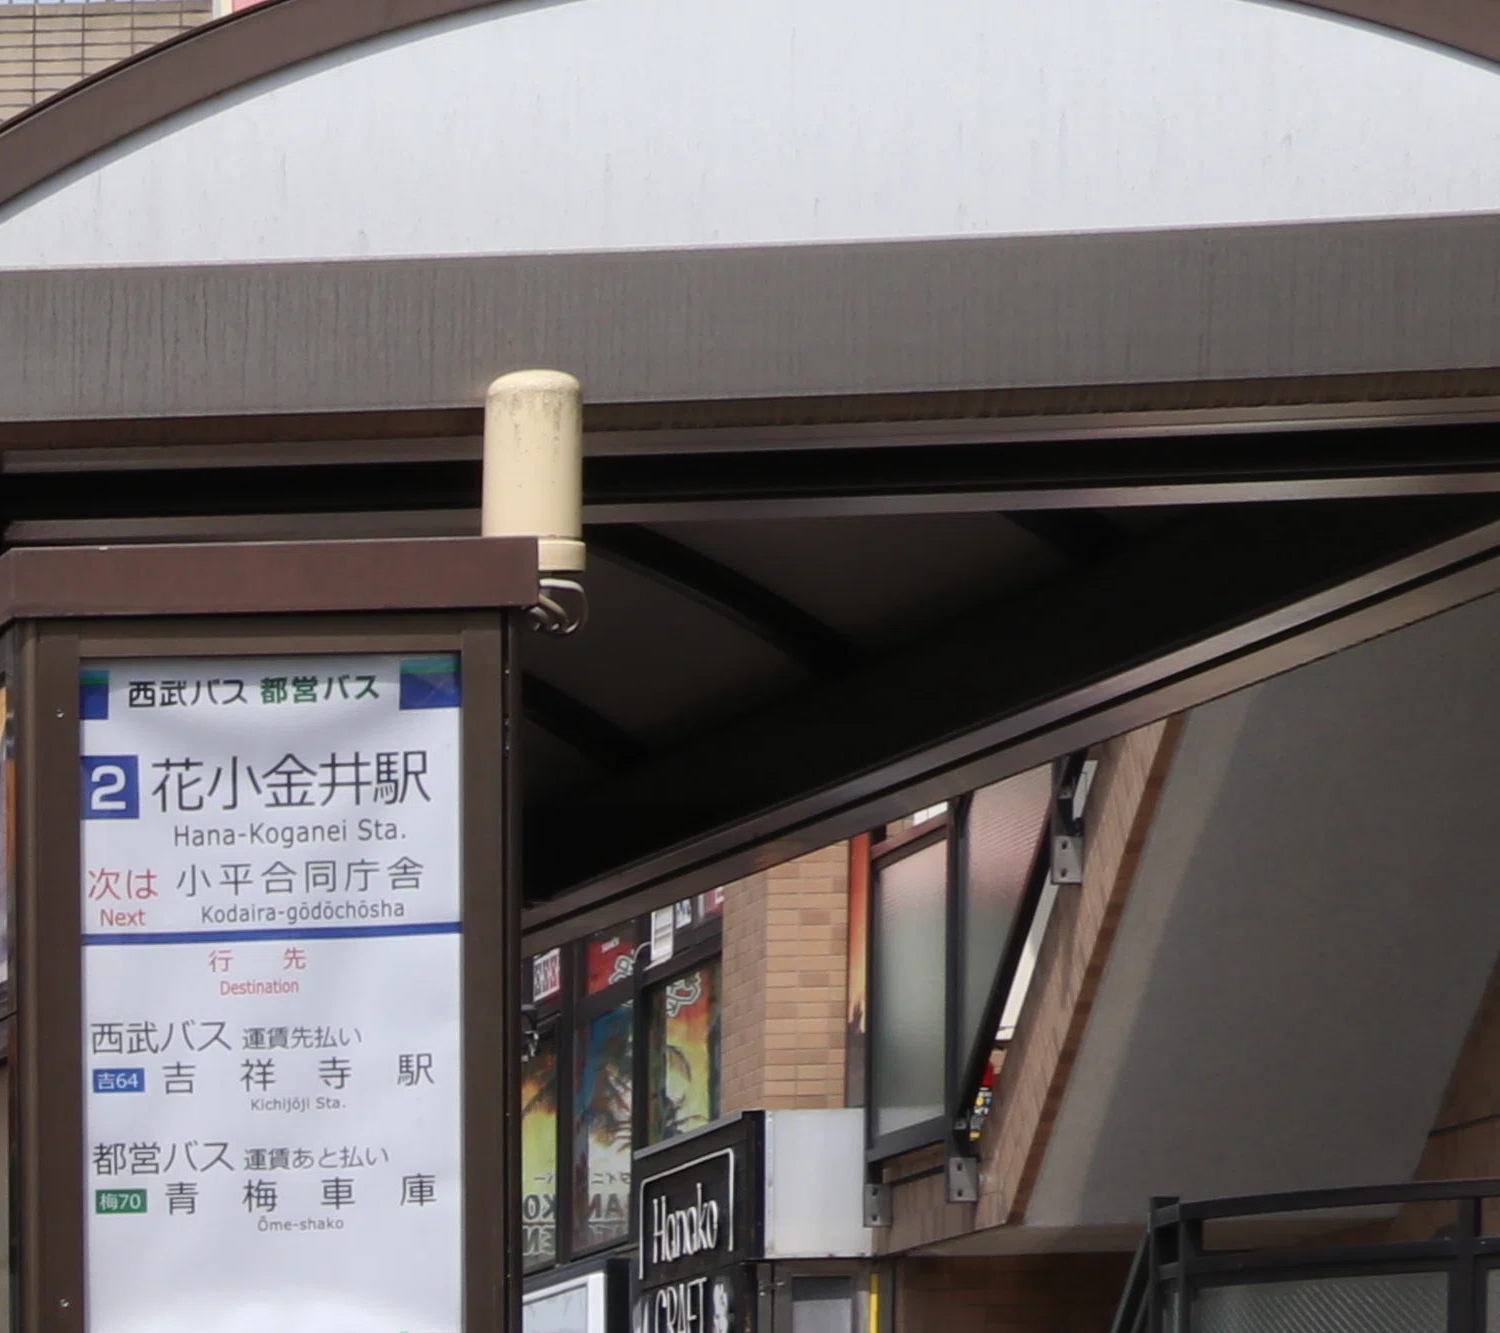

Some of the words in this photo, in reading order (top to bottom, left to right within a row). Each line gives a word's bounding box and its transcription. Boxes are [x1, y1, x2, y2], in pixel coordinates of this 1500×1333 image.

[128, 678, 248, 708] 西武バス
[260, 675, 381, 705] 都営バス
[90, 765, 126, 812] 2
[150, 749, 431, 813] 花小金井駅
[173, 820, 348, 847] Hana-Koganei
[357, 818, 407, 841] Sta.
[87, 868, 158, 901] 次は
[175, 856, 425, 895] 小平合同庁舎
[100, 907, 146, 927] Next
[219, 977, 299, 995] Destination
[90, 1019, 233, 1055] 西武バス
[241, 1026, 363, 1050] 運賃先払い
[98, 1072, 139, 1090] 吉64
[161, 1053, 435, 1095] 吉祥寺駅
[315, 1096, 347, 1110] Sta.
[92, 1141, 235, 1176] 都営バス
[243, 1145, 390, 1170] 運賃あと払い
[99, 1193, 142, 1211] 梅70
[164, 1173, 437, 1216] 青梅車庫
[653, 1182, 719, 1263] Hanako
